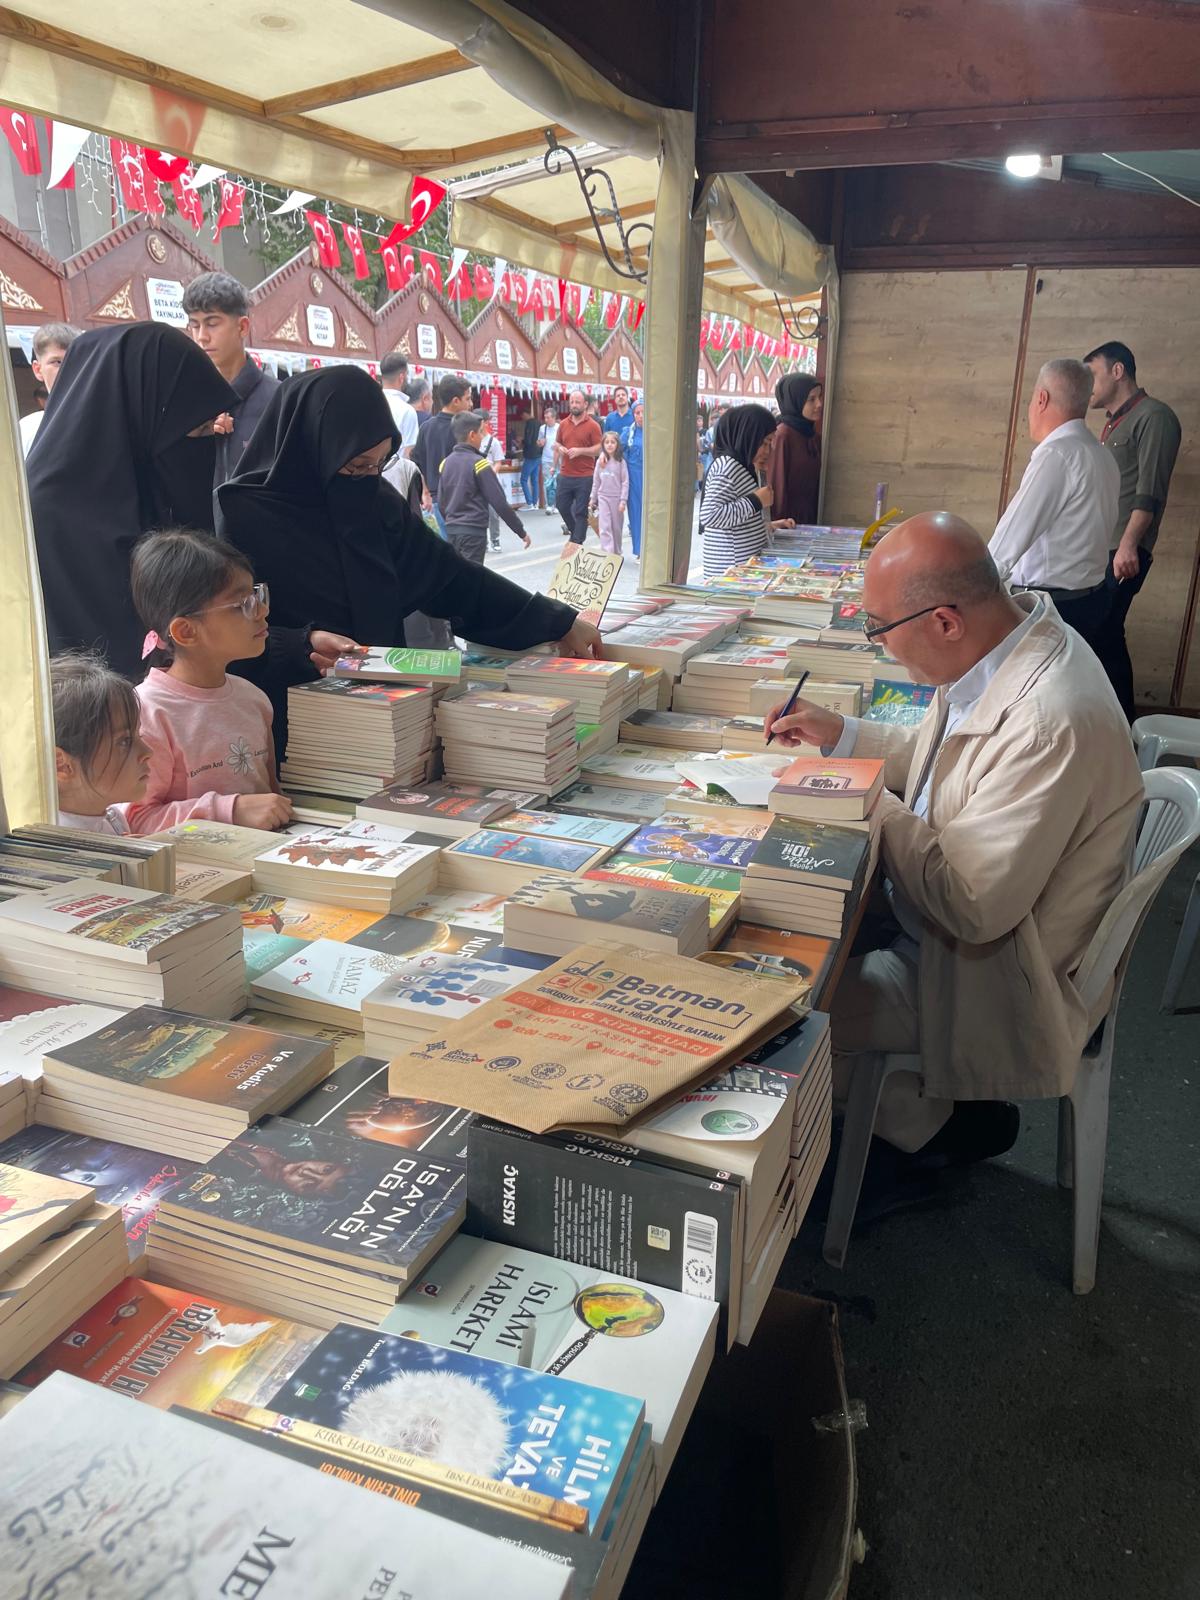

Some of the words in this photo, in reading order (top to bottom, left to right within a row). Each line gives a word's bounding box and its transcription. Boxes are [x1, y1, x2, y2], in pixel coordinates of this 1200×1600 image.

[155, 310, 185, 320] YAYINLARI
[338, 956, 367, 996] NAMAZ
[597, 988, 684, 1019] Fuarı
[616, 975, 746, 1016] Batman
[591, 1026, 637, 1046] KASIM
[599, 1014, 652, 1037] KİTAP
[654, 1033, 709, 1055] FUARI
[684, 1026, 726, 1042] BATMAN
[270, 1049, 295, 1063] Ve
[236, 1062, 273, 1091] Kudüs
[330, 1157, 418, 1242] OĞLAĞI
[359, 1163, 452, 1250] İSA'NIN
[502, 1164, 519, 1227] KISKAÇ
[449, 1262, 525, 1354] HAREKET
[127, 1301, 221, 1379] İBRAHİM
[314, 1427, 345, 1447] KIRK
[346, 1438, 387, 1462] HADİS
[546, 1455, 568, 1478] VE
